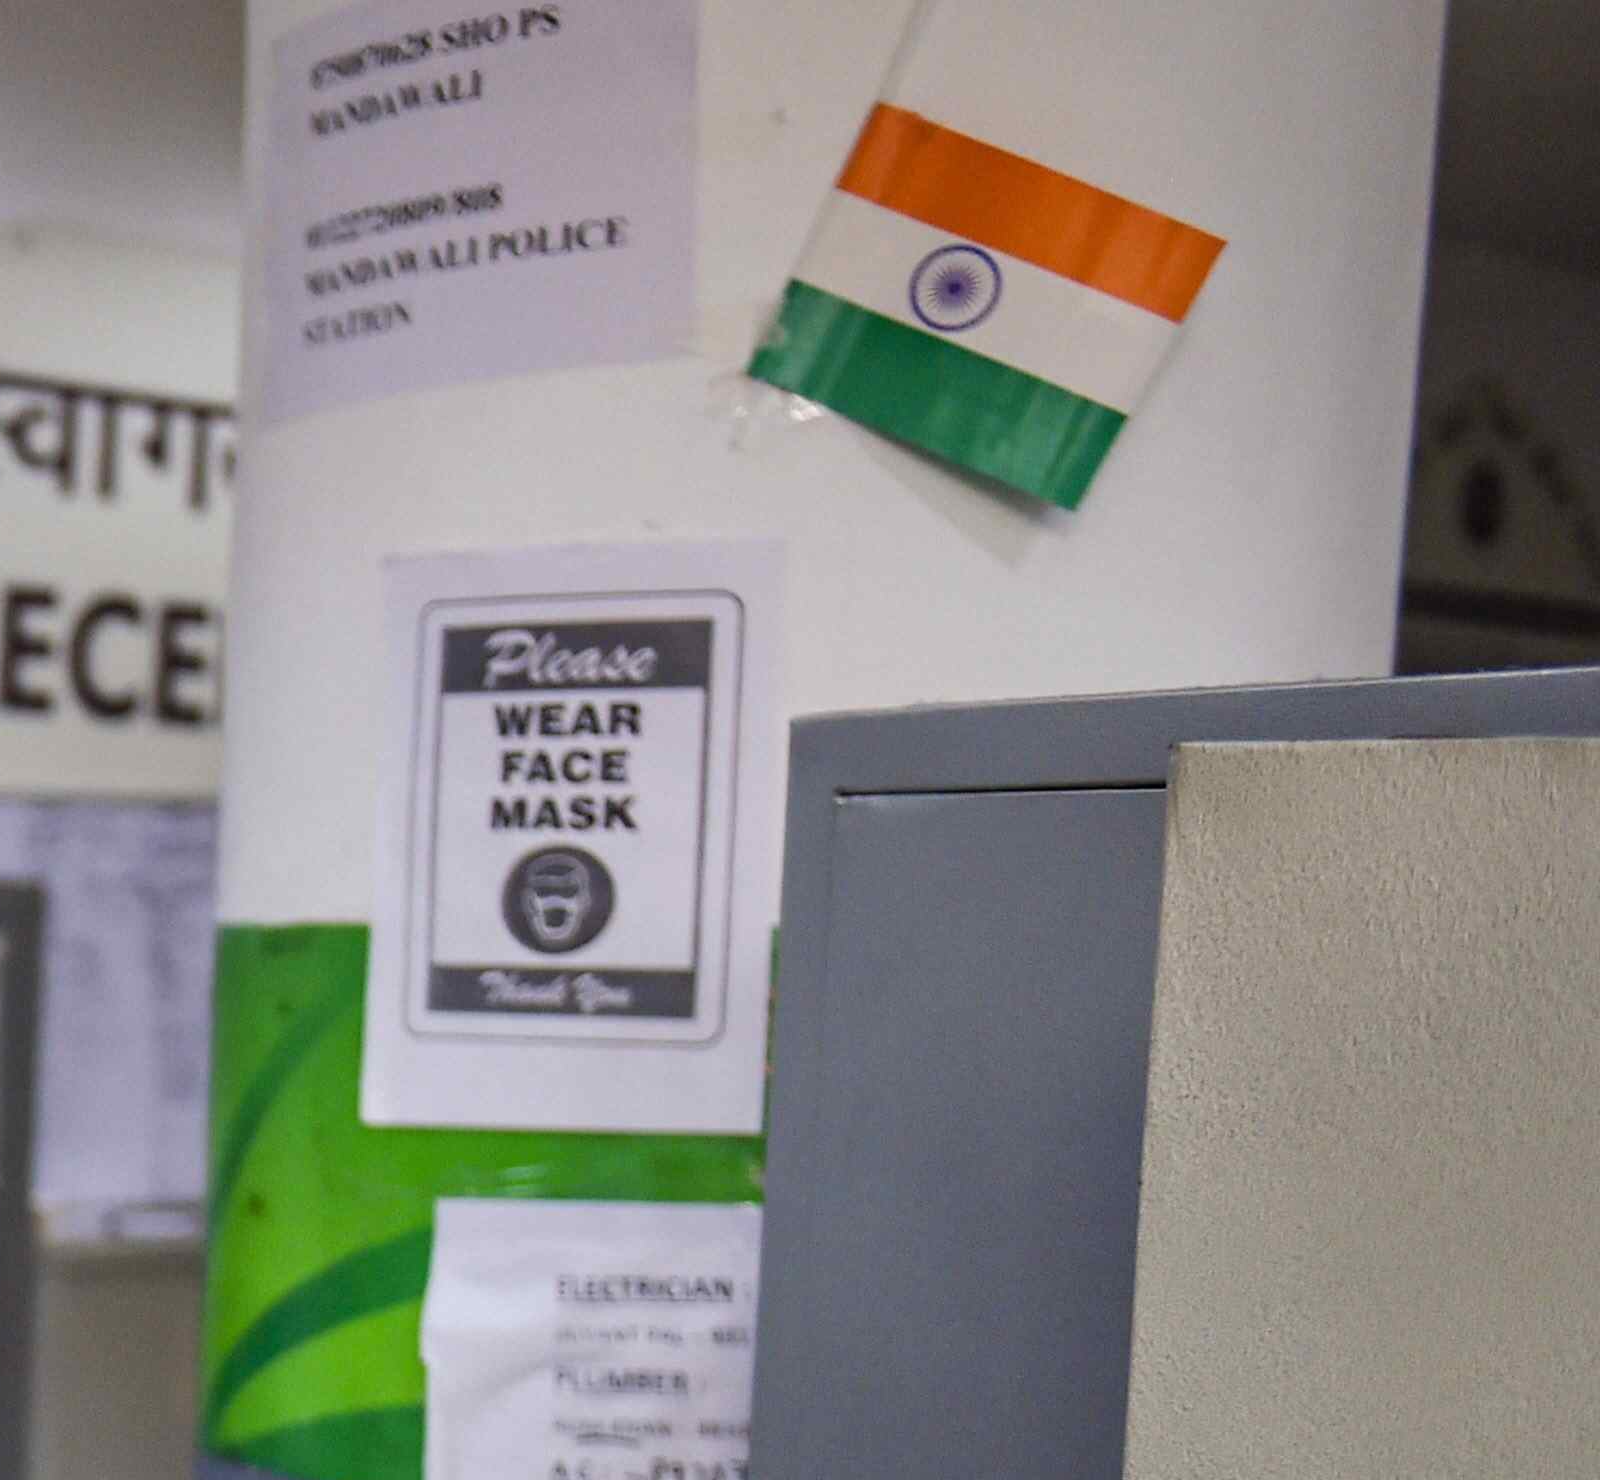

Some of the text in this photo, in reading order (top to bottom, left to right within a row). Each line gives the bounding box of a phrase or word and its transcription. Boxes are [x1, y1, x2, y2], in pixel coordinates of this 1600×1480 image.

[439, 13, 508, 52] SHO
[517, 4, 561, 38] PS
[310, 69, 483, 134] MANDAWALI
[305, 217, 629, 296] MANDAWALI POLICE
[302, 300, 411, 346] STATION
[483, 630, 659, 688] Please
[492, 702, 642, 738] WEAR
[499, 750, 629, 785] FACE
[489, 797, 639, 832] MASK
[480, 970, 631, 1013] Thank You
[557, 1274, 734, 1300] ELECTRICIAN
[556, 1365, 688, 1393] PLUMBER
